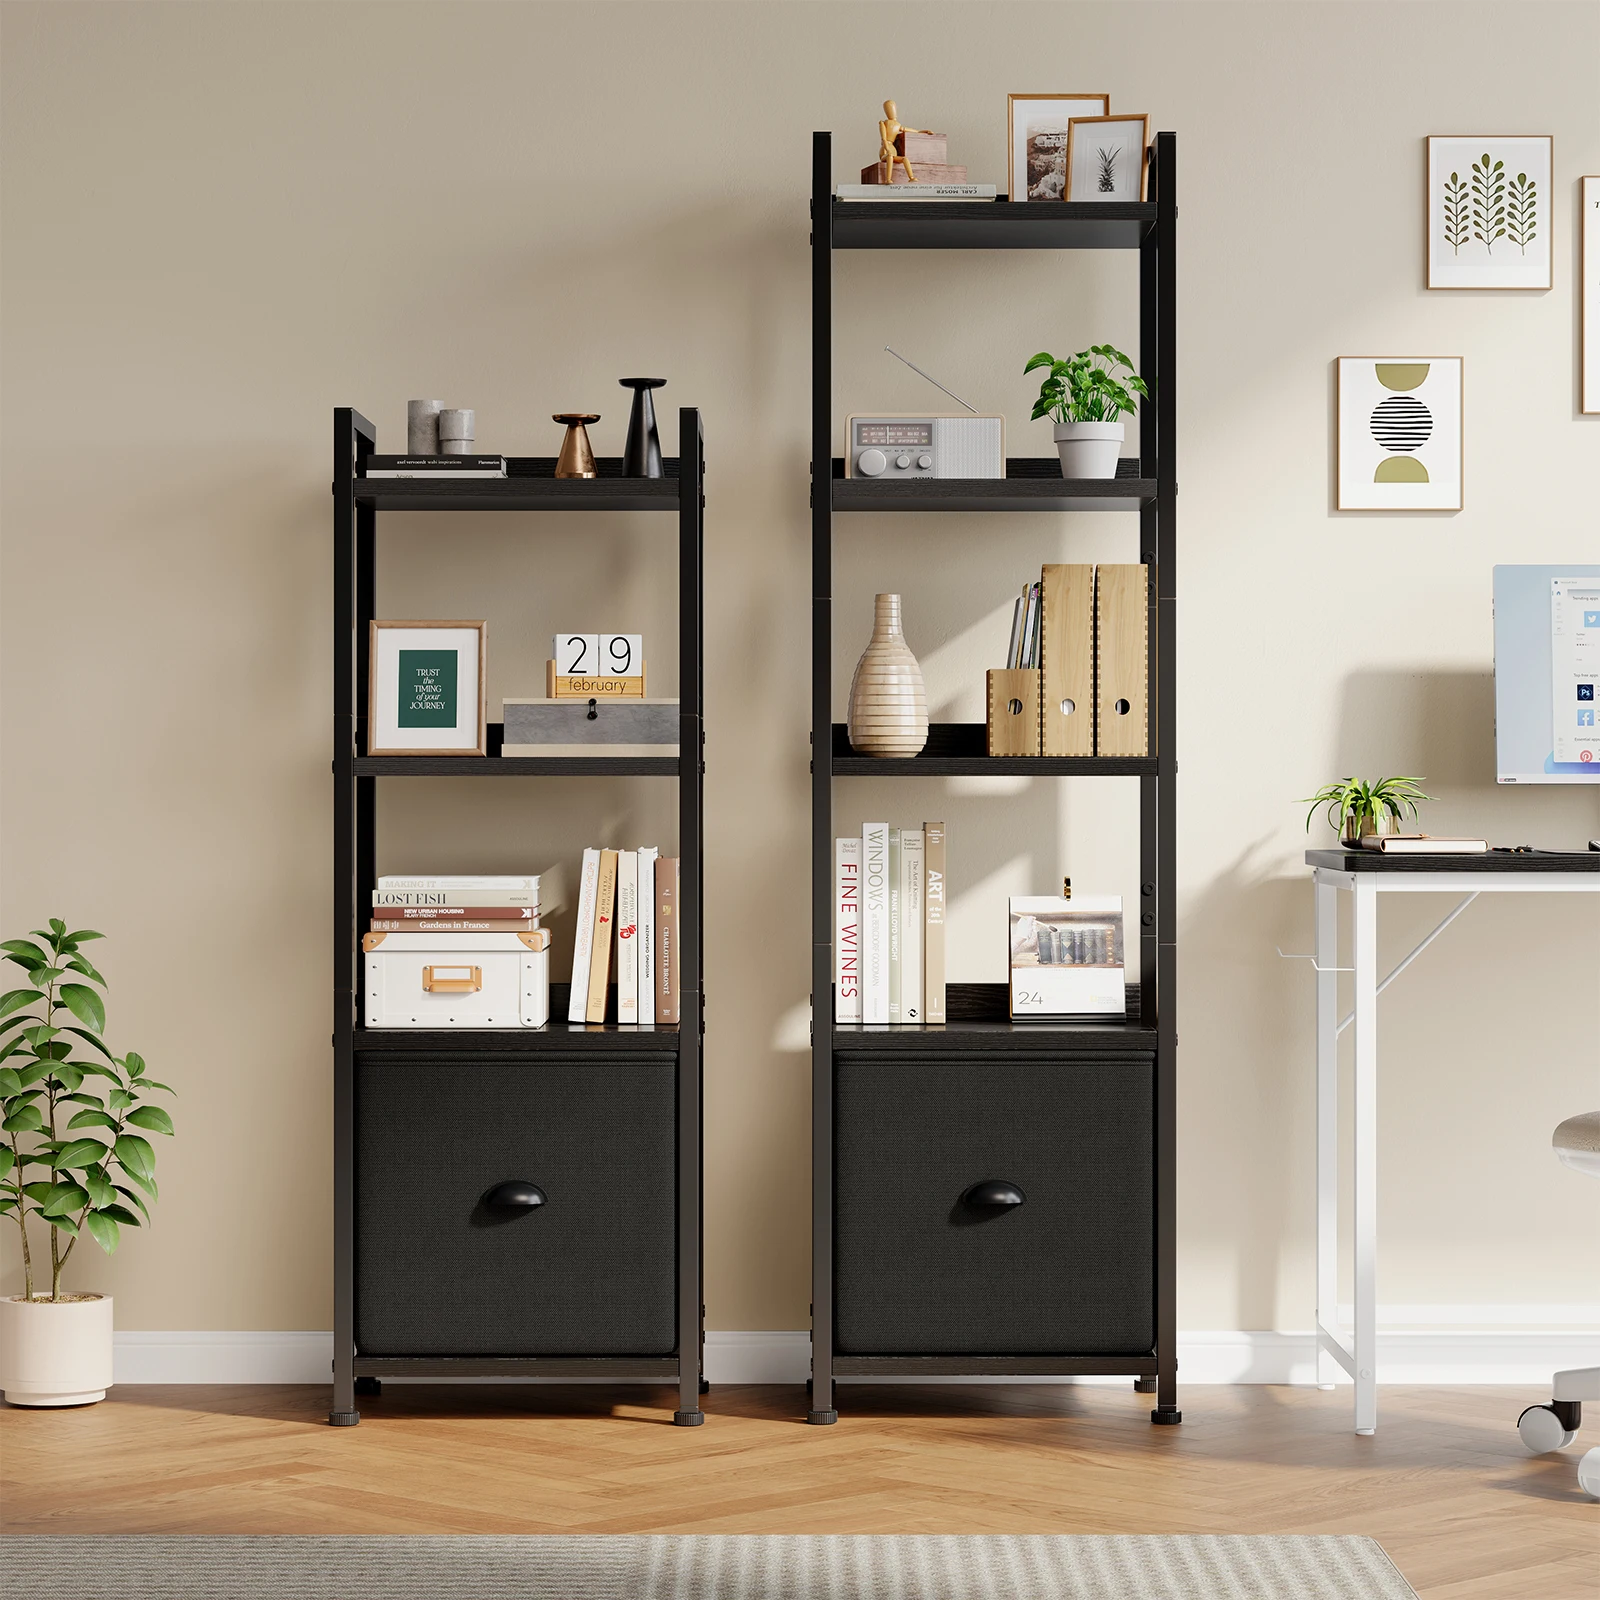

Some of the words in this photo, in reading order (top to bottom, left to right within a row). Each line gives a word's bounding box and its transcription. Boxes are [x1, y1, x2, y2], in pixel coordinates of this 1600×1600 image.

[416, 668, 440, 676] TRUST
[422, 676, 434, 684] the
[569, 676, 626, 694] february
[414, 684, 442, 692] TIMING
[416, 692, 424, 701] of
[409, 702, 446, 710] JOURNEY
[868, 829, 884, 911] WINDOWS
[842, 864, 858, 912] FINE
[928, 870, 942, 902] ART
[377, 893, 412, 904] LOST
[416, 893, 446, 904] FISH
[420, 920, 452, 929] Gardens
[454, 920, 461, 928] in
[842, 924, 858, 998] WINES
[1018, 992, 1044, 1005] 24
